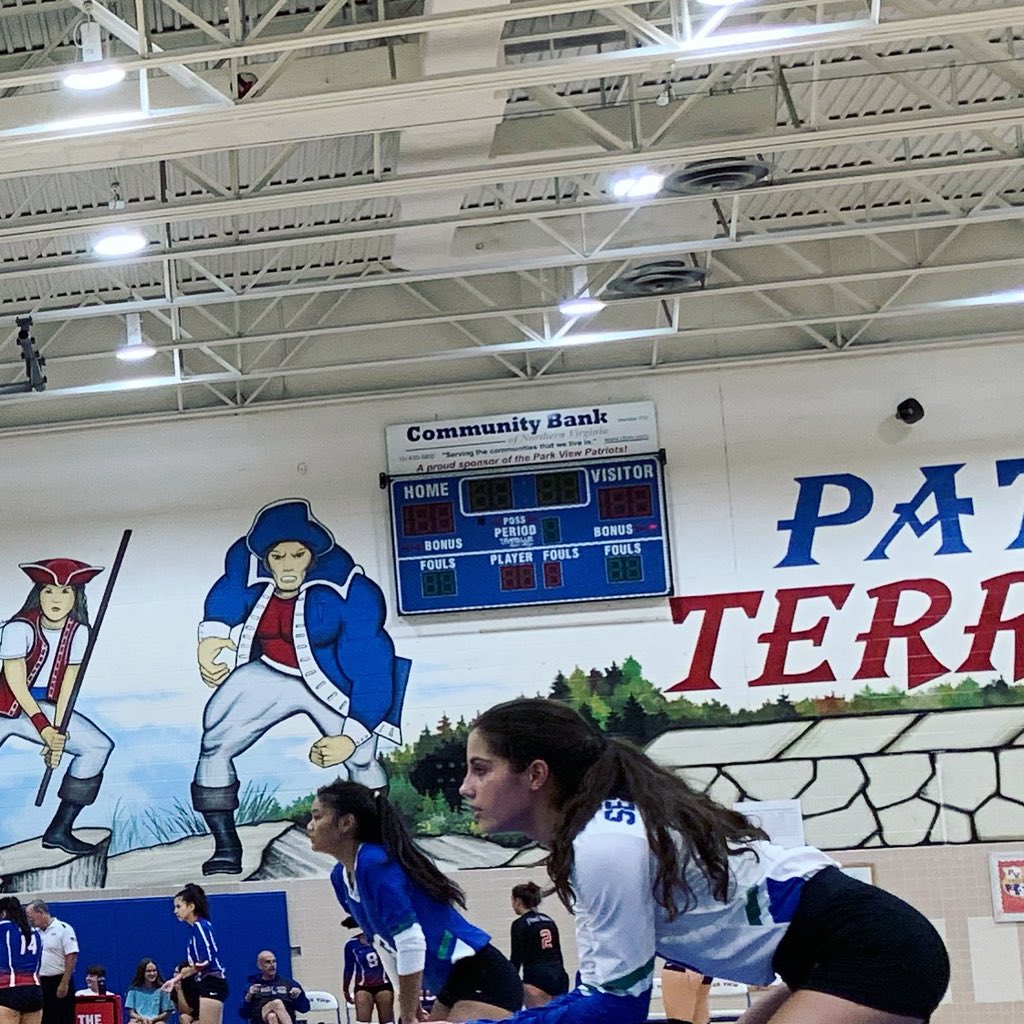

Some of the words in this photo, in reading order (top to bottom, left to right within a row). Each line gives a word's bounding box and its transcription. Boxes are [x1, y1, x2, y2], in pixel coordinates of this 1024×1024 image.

[407, 416, 540, 441] Community
[547, 409, 607, 429] Bank
[569, 427, 608, 438] Virginia
[417, 464, 424, 472] A
[427, 461, 455, 473] proud
[459, 458, 498, 470] sponsor
[502, 455, 512, 464] of
[515, 454, 531, 463] the
[533, 451, 555, 461] Park
[559, 449, 582, 459] View
[584, 445, 628, 457] Patriots!
[591, 464, 654, 483] VISITOR
[404, 482, 449, 499] HOME
[503, 516, 526, 525] POSS
[494, 525, 536, 538] PERIOD
[594, 524, 633, 537] BONUS
[424, 538, 463, 551] BONUS
[604, 543, 641, 556] FOULS
[420, 558, 456, 570] FOULS
[490, 552, 533, 565] PLAYER
[543, 548, 580, 561] FOULS
[663, 570, 1024, 693] TERR
[540, 929, 553, 949] 2
